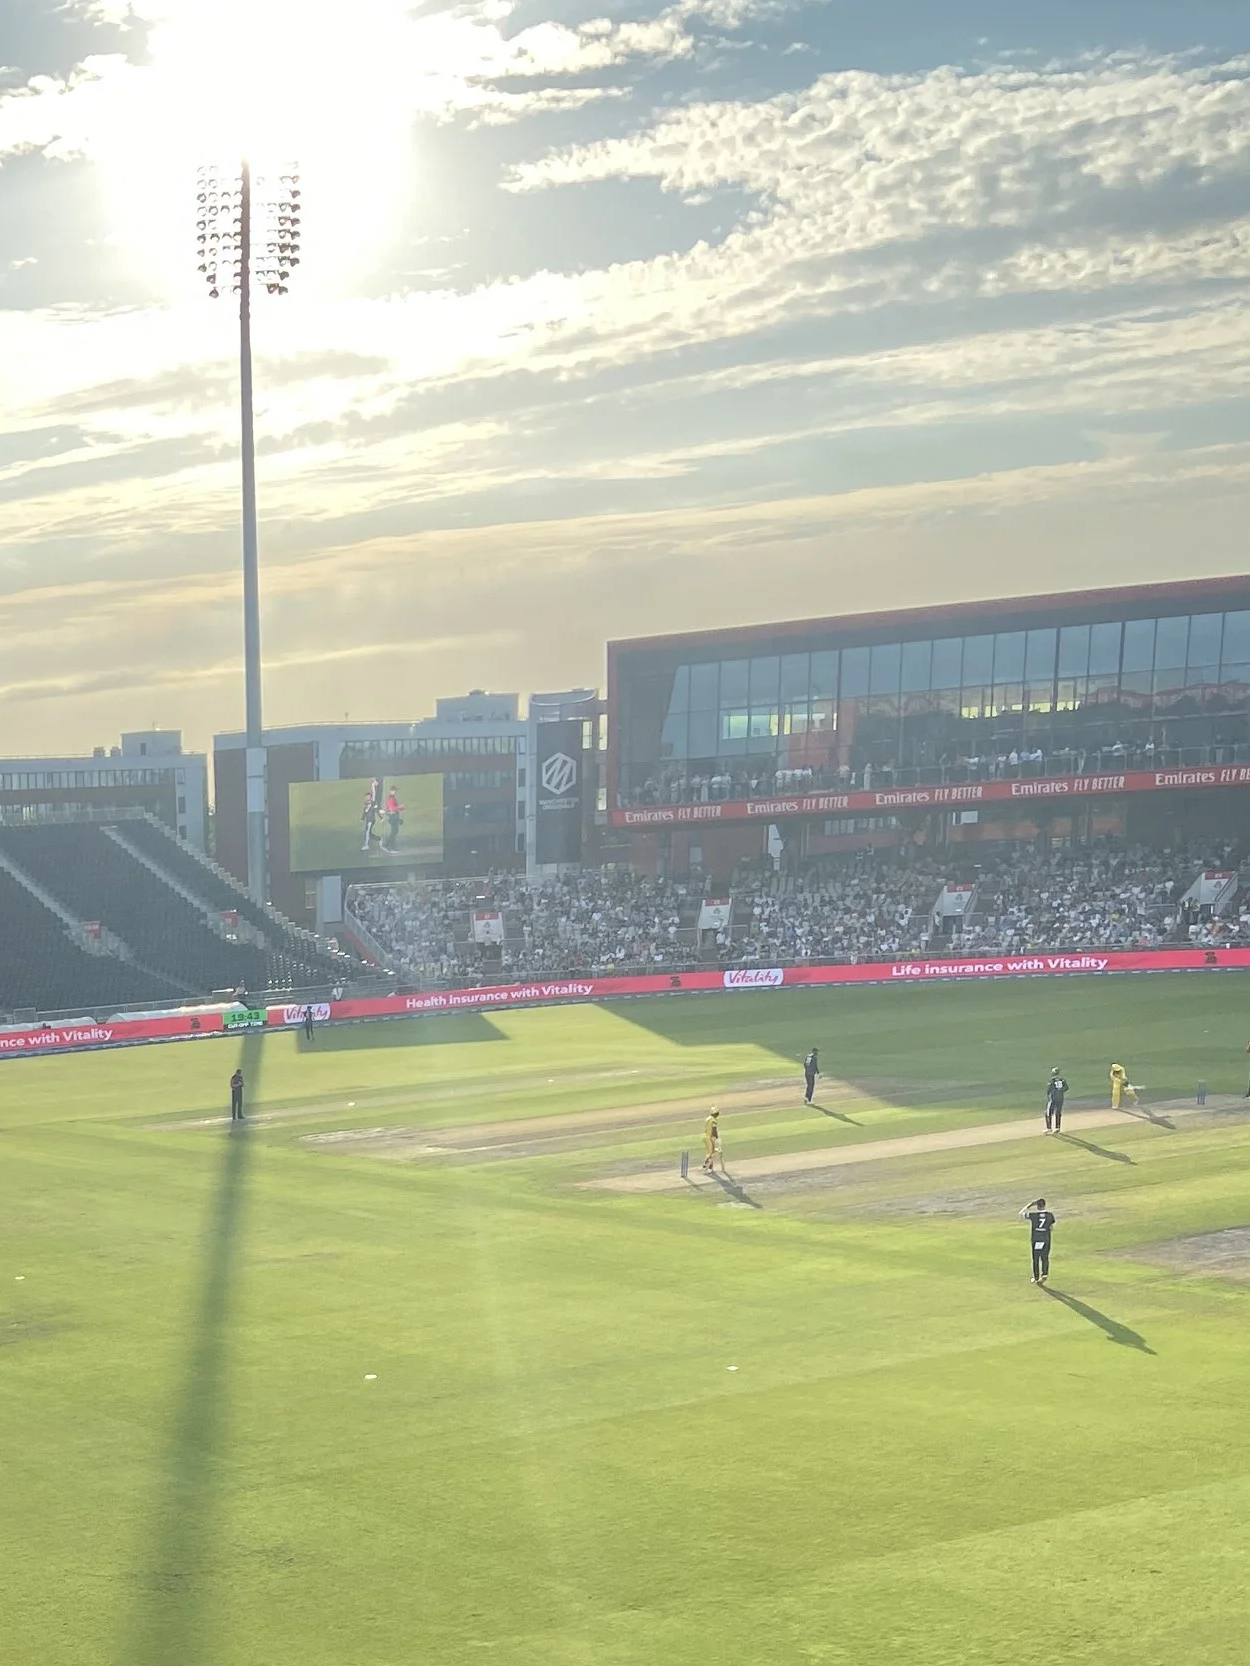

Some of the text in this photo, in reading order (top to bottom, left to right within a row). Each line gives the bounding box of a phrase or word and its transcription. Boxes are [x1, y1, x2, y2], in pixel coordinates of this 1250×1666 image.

[1011, 776, 1125, 796] Emirates FLY BETTER
[1155, 771, 1215, 786] Emirates
[1220, 769, 1238, 782] FLY
[875, 787, 983, 805] Emirates FLY BETTER
[746, 796, 848, 814] Emirates FLY BETTER
[625, 806, 721, 823] Emirates FLY BETTER
[893, 956, 1108, 976] Life insurance with Vitality
[729, 970, 779, 985] Vitality
[406, 984, 593, 1008] Health insurance with Vitality
[28, 1032, 60, 1045] with
[62, 1028, 113, 1042] Vitality
[1039, 1218, 1046, 1227] 7
